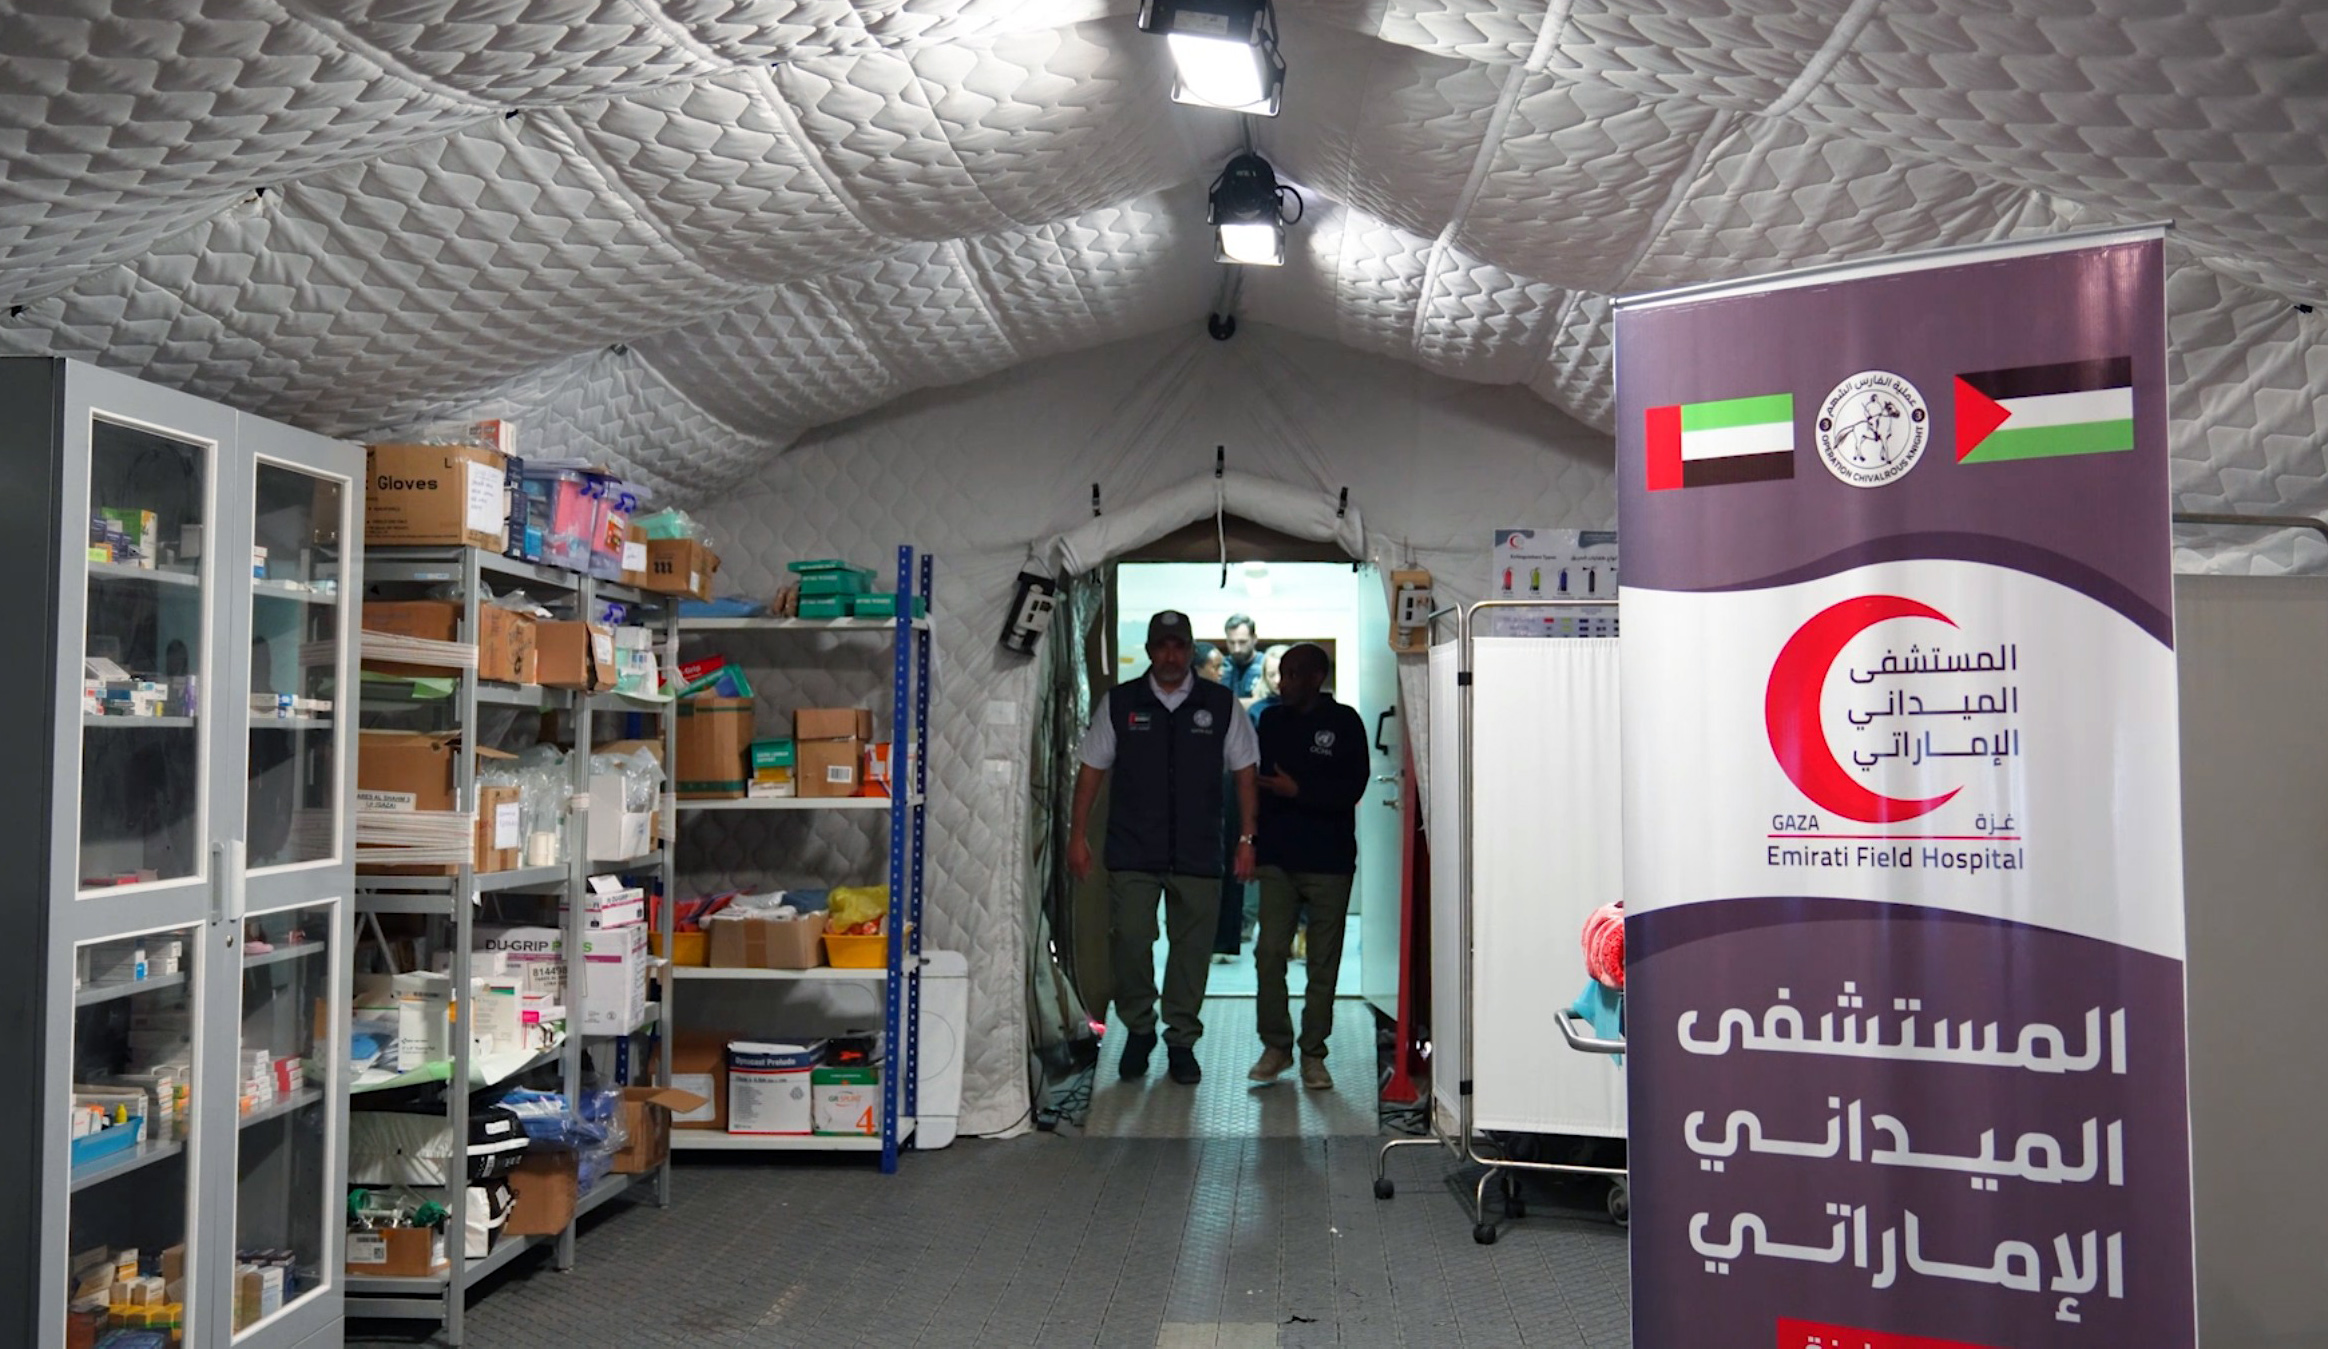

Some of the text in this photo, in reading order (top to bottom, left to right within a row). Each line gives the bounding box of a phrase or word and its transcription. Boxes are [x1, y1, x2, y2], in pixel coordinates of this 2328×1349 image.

[1854, 374, 1893, 390] الفارس
[1827, 382, 1853, 418] الشهم
[444, 457, 452, 469] L
[1822, 426, 1923, 482] OPERATION CHIVALROUS KNIGHT
[377, 475, 438, 490] Gloves
[1850, 644, 2017, 684] المستشفى
[1848, 686, 2018, 730] الميداني
[1853, 729, 2019, 771] الإماراتي
[1772, 814, 1819, 831] GAZA
[1975, 812, 2015, 834] غزة
[1767, 845, 2024, 875] Emirati Field Hospital
[485, 939, 592, 953] DU-GRIP PS
[1677, 981, 2127, 1074] المستشفى
[856, 1105, 876, 1135] 4
[1684, 1095, 2124, 1192] الميداني
[1689, 1202, 2124, 1323] الإماراتي
